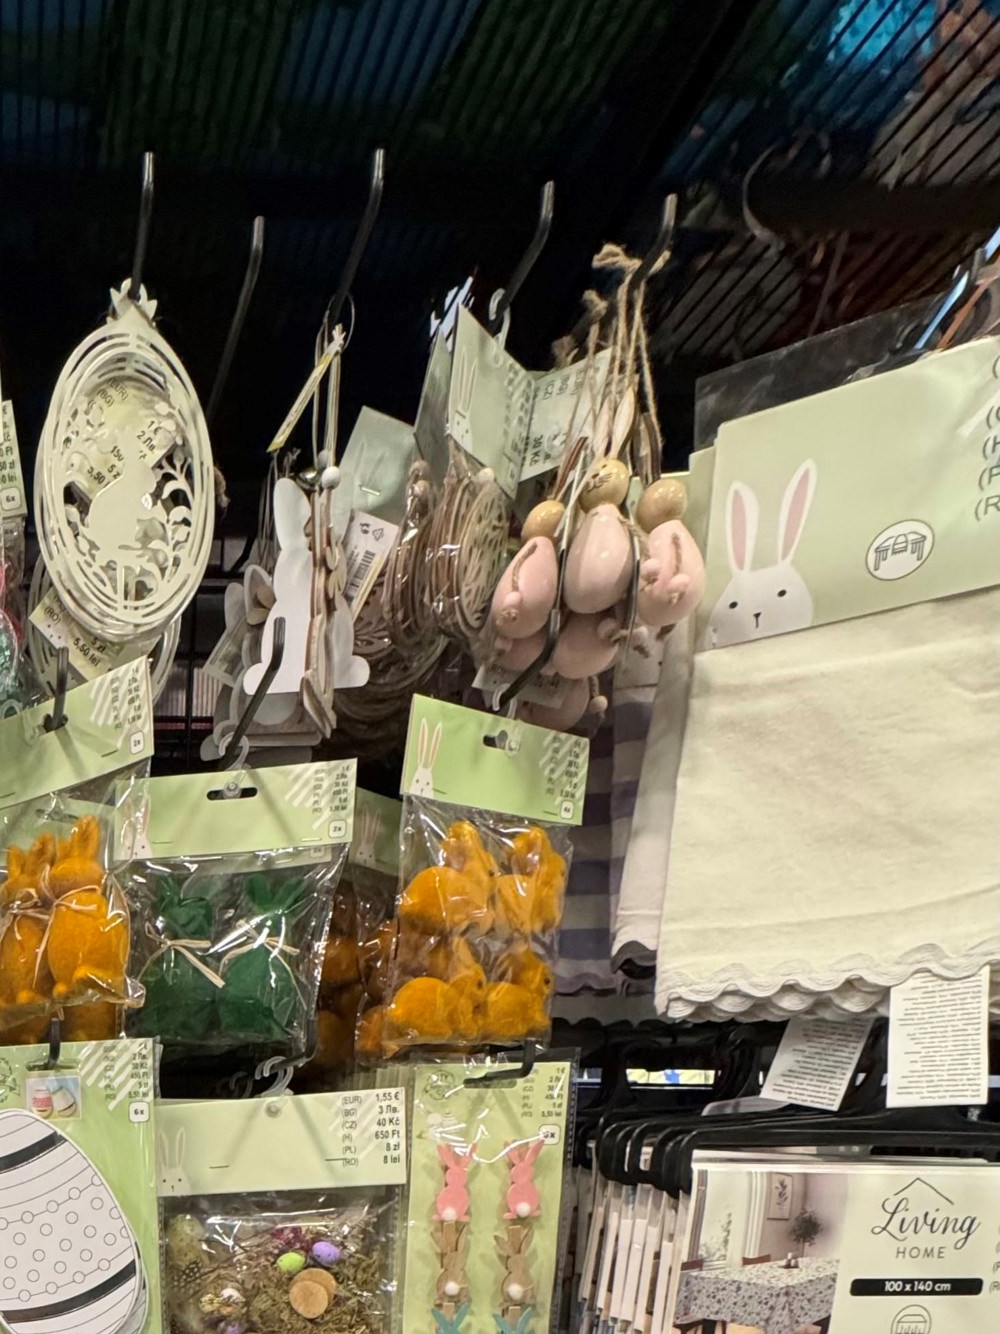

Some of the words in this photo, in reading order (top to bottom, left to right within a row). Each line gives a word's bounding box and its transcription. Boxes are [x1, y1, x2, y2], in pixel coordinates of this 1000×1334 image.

[96, 388, 115, 407] (BG)
[136, 430, 146, 441] 2
[532, 434, 543, 449] 30
[44, 606, 61, 625] (RO)
[73, 637, 90, 656] 5,50
[88, 653, 102, 667] lei
[342, 1095, 363, 1106] (EUR)
[375, 1092, 392, 1103] 1,55
[394, 1091, 400, 1101] €
[342, 1108, 358, 1119] (BG)
[378, 1105, 384, 1115] 3
[385, 1104, 400, 1114] Лв.
[342, 1120, 357, 1131] (CZ)
[376, 1117, 386, 1127] 40
[388, 1116, 400, 1126] Kč
[342, 1133, 353, 1143] (H)
[374, 1130, 390, 1140] 650
[391, 1129, 400, 1139] Ft
[342, 1145, 357, 1155] (PL)
[386, 1142, 391, 1152] 8
[393, 1142, 400, 1151] zł
[383, 1155, 388, 1164] 8
[390, 1154, 400, 1164] lei
[870, 1197, 982, 1250] Living
[896, 1246, 946, 1259] HOME
[884, 1281, 902, 1292] 100
[903, 1282, 912, 1292] x
[913, 1281, 933, 1292] 140
[934, 1282, 952, 1291] cm
